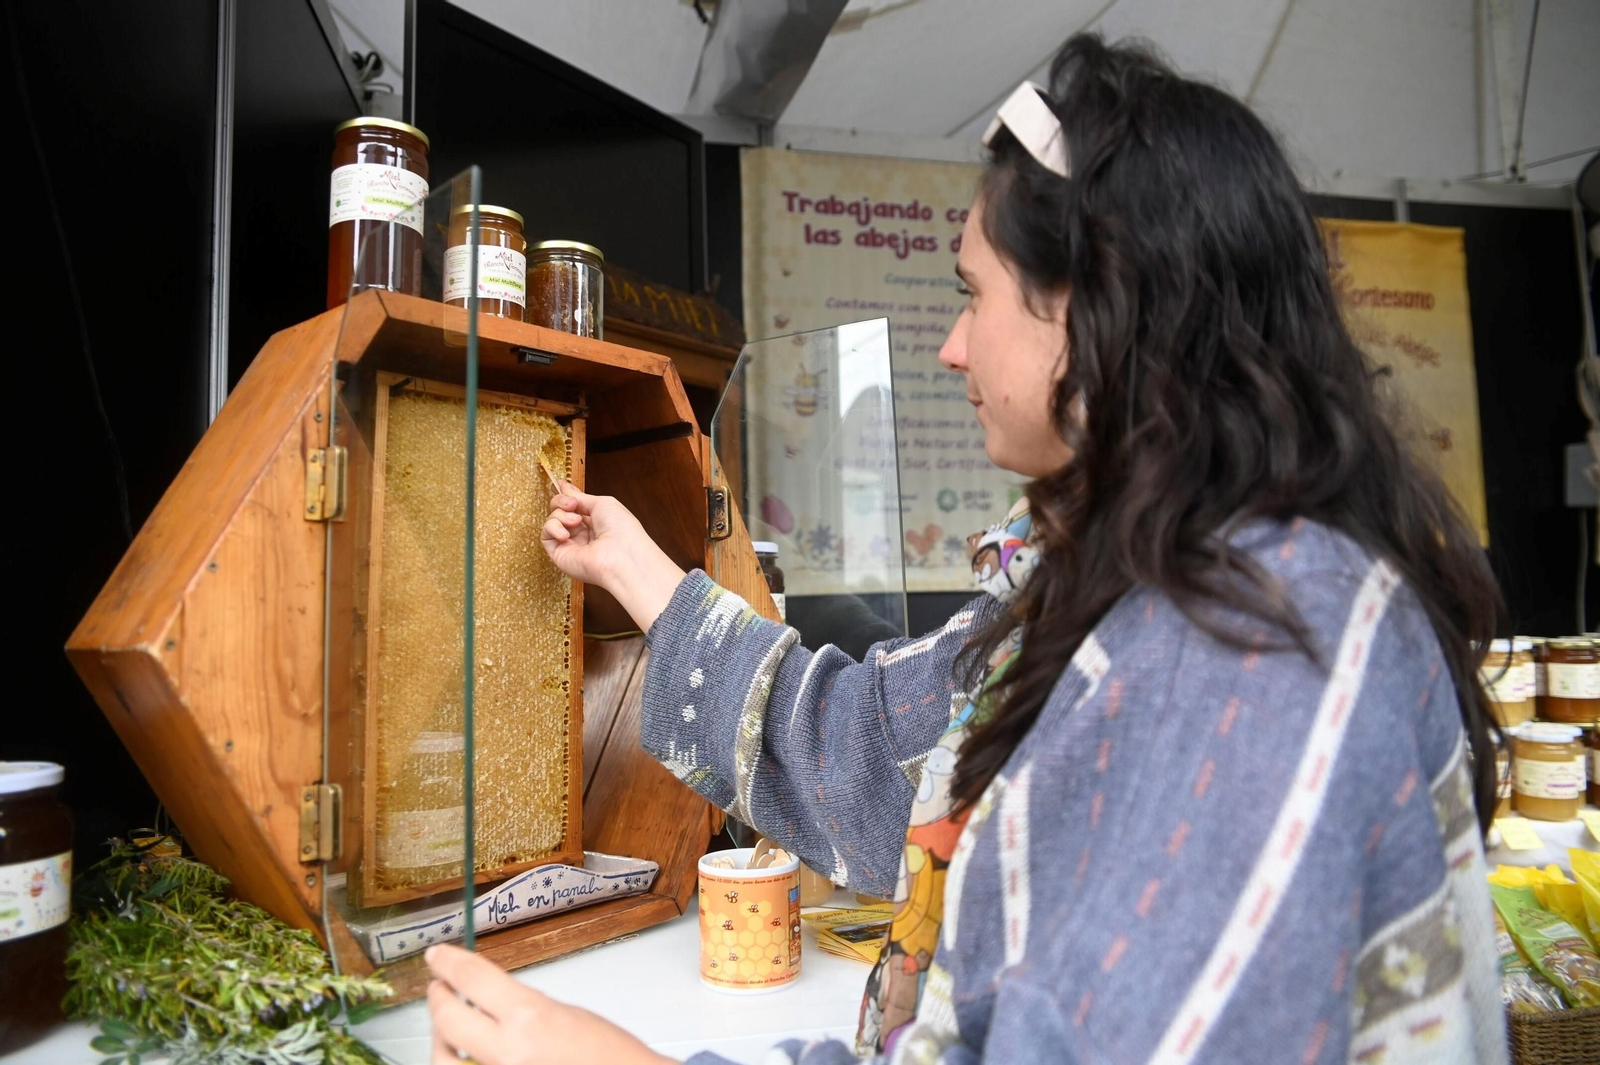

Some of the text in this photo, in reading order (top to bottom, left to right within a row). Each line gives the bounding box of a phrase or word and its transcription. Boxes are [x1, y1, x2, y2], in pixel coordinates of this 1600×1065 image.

[782, 191, 968, 226] Trabajando co
[804, 224, 963, 260] las abejas d
[825, 297, 895, 313] Contamos
[488, 877, 604, 924] Miel en panal
